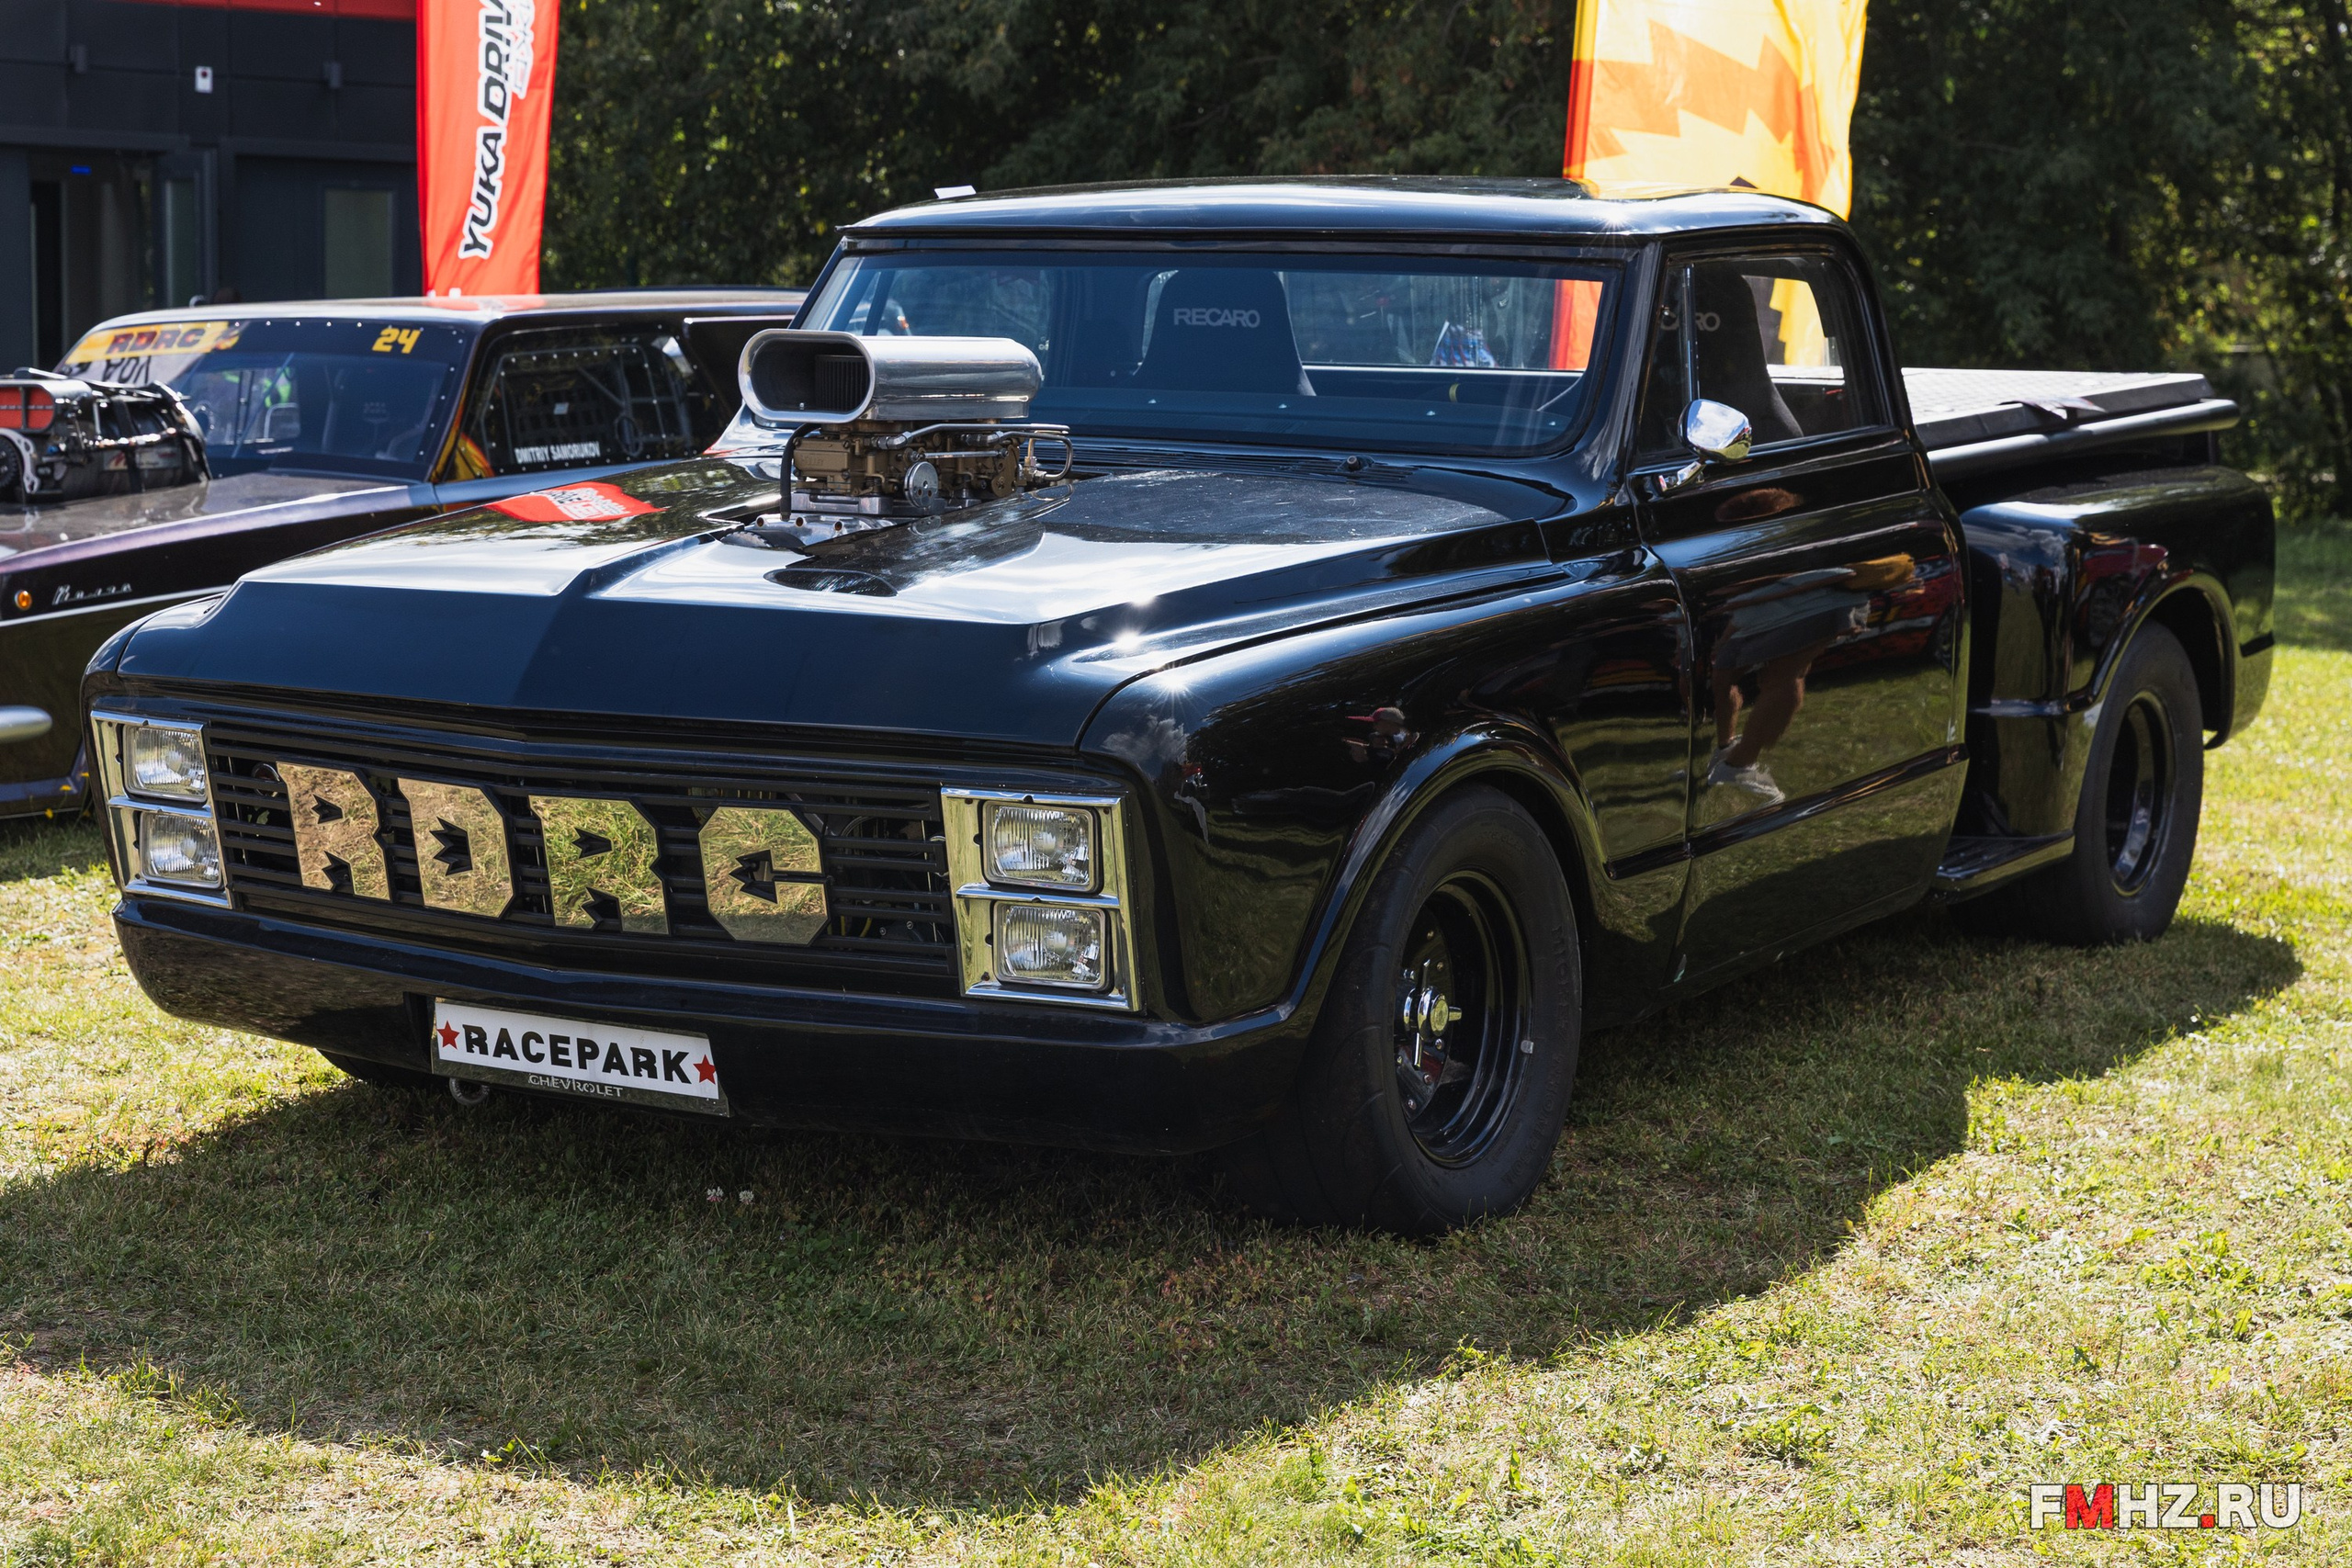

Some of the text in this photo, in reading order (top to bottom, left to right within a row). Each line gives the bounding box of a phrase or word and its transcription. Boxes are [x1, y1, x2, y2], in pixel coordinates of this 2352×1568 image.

[463, 131, 503, 254] YUKA
[1173, 308, 1261, 328] RECARO
[106, 327, 206, 355] RDRC
[372, 327, 421, 354] 24
[275, 761, 829, 946] RDRC
[462, 1024, 692, 1085] RACEPARK
[527, 1074, 624, 1098] CHEVROLET
